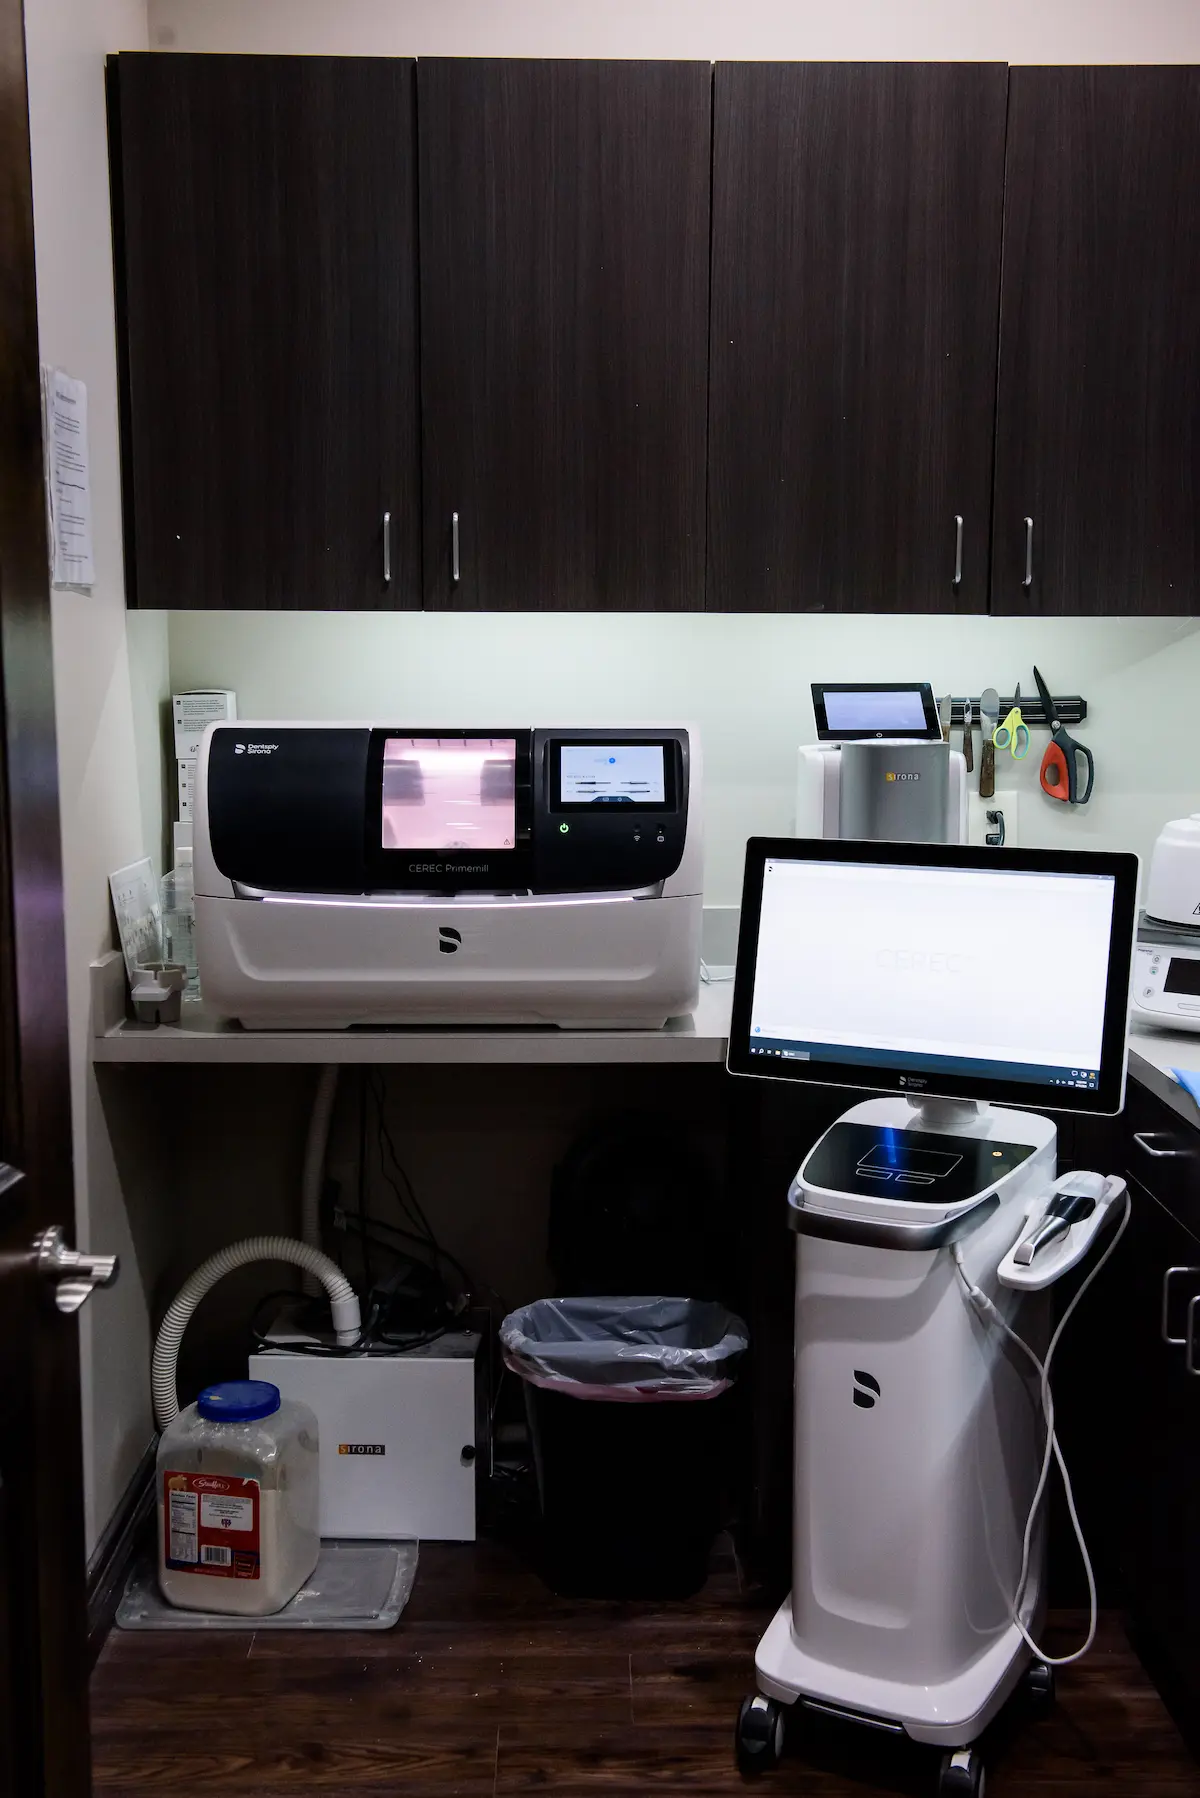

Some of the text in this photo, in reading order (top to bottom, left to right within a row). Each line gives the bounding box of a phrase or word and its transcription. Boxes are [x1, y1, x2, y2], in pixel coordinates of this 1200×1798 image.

[886, 772, 920, 781] sirona
[408, 863, 489, 873] CEREC Primemill
[339, 1445, 384, 1455] sirona
